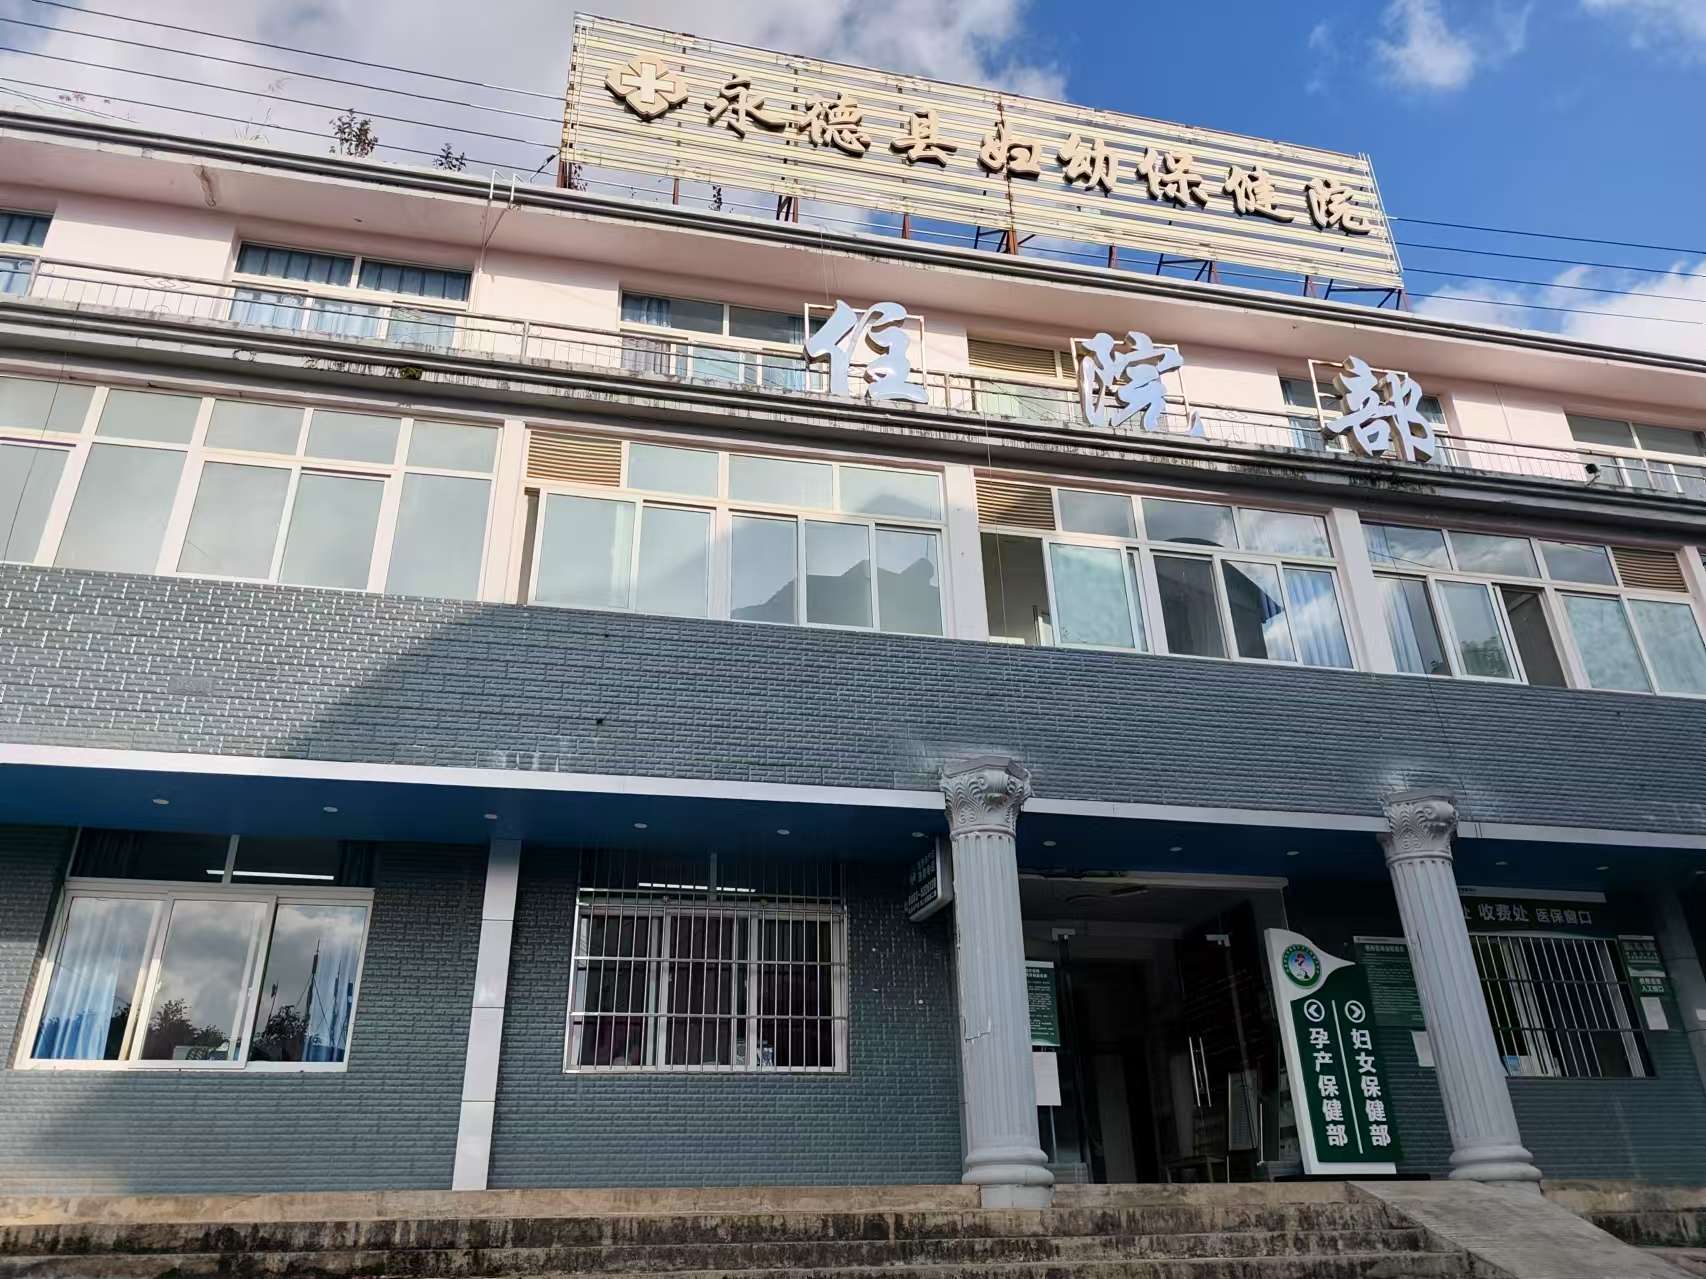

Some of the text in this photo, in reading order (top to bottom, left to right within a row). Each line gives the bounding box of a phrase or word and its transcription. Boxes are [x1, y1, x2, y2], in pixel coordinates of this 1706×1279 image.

[704, 72, 1371, 236] 永德县妇幼保健院
[805, 299, 1436, 462] 住院部
[1478, 903, 1529, 922] 收费处
[1308, 1027, 1349, 1147] 孕产保健部
[1350, 1028, 1392, 1147] 妇女保健部
